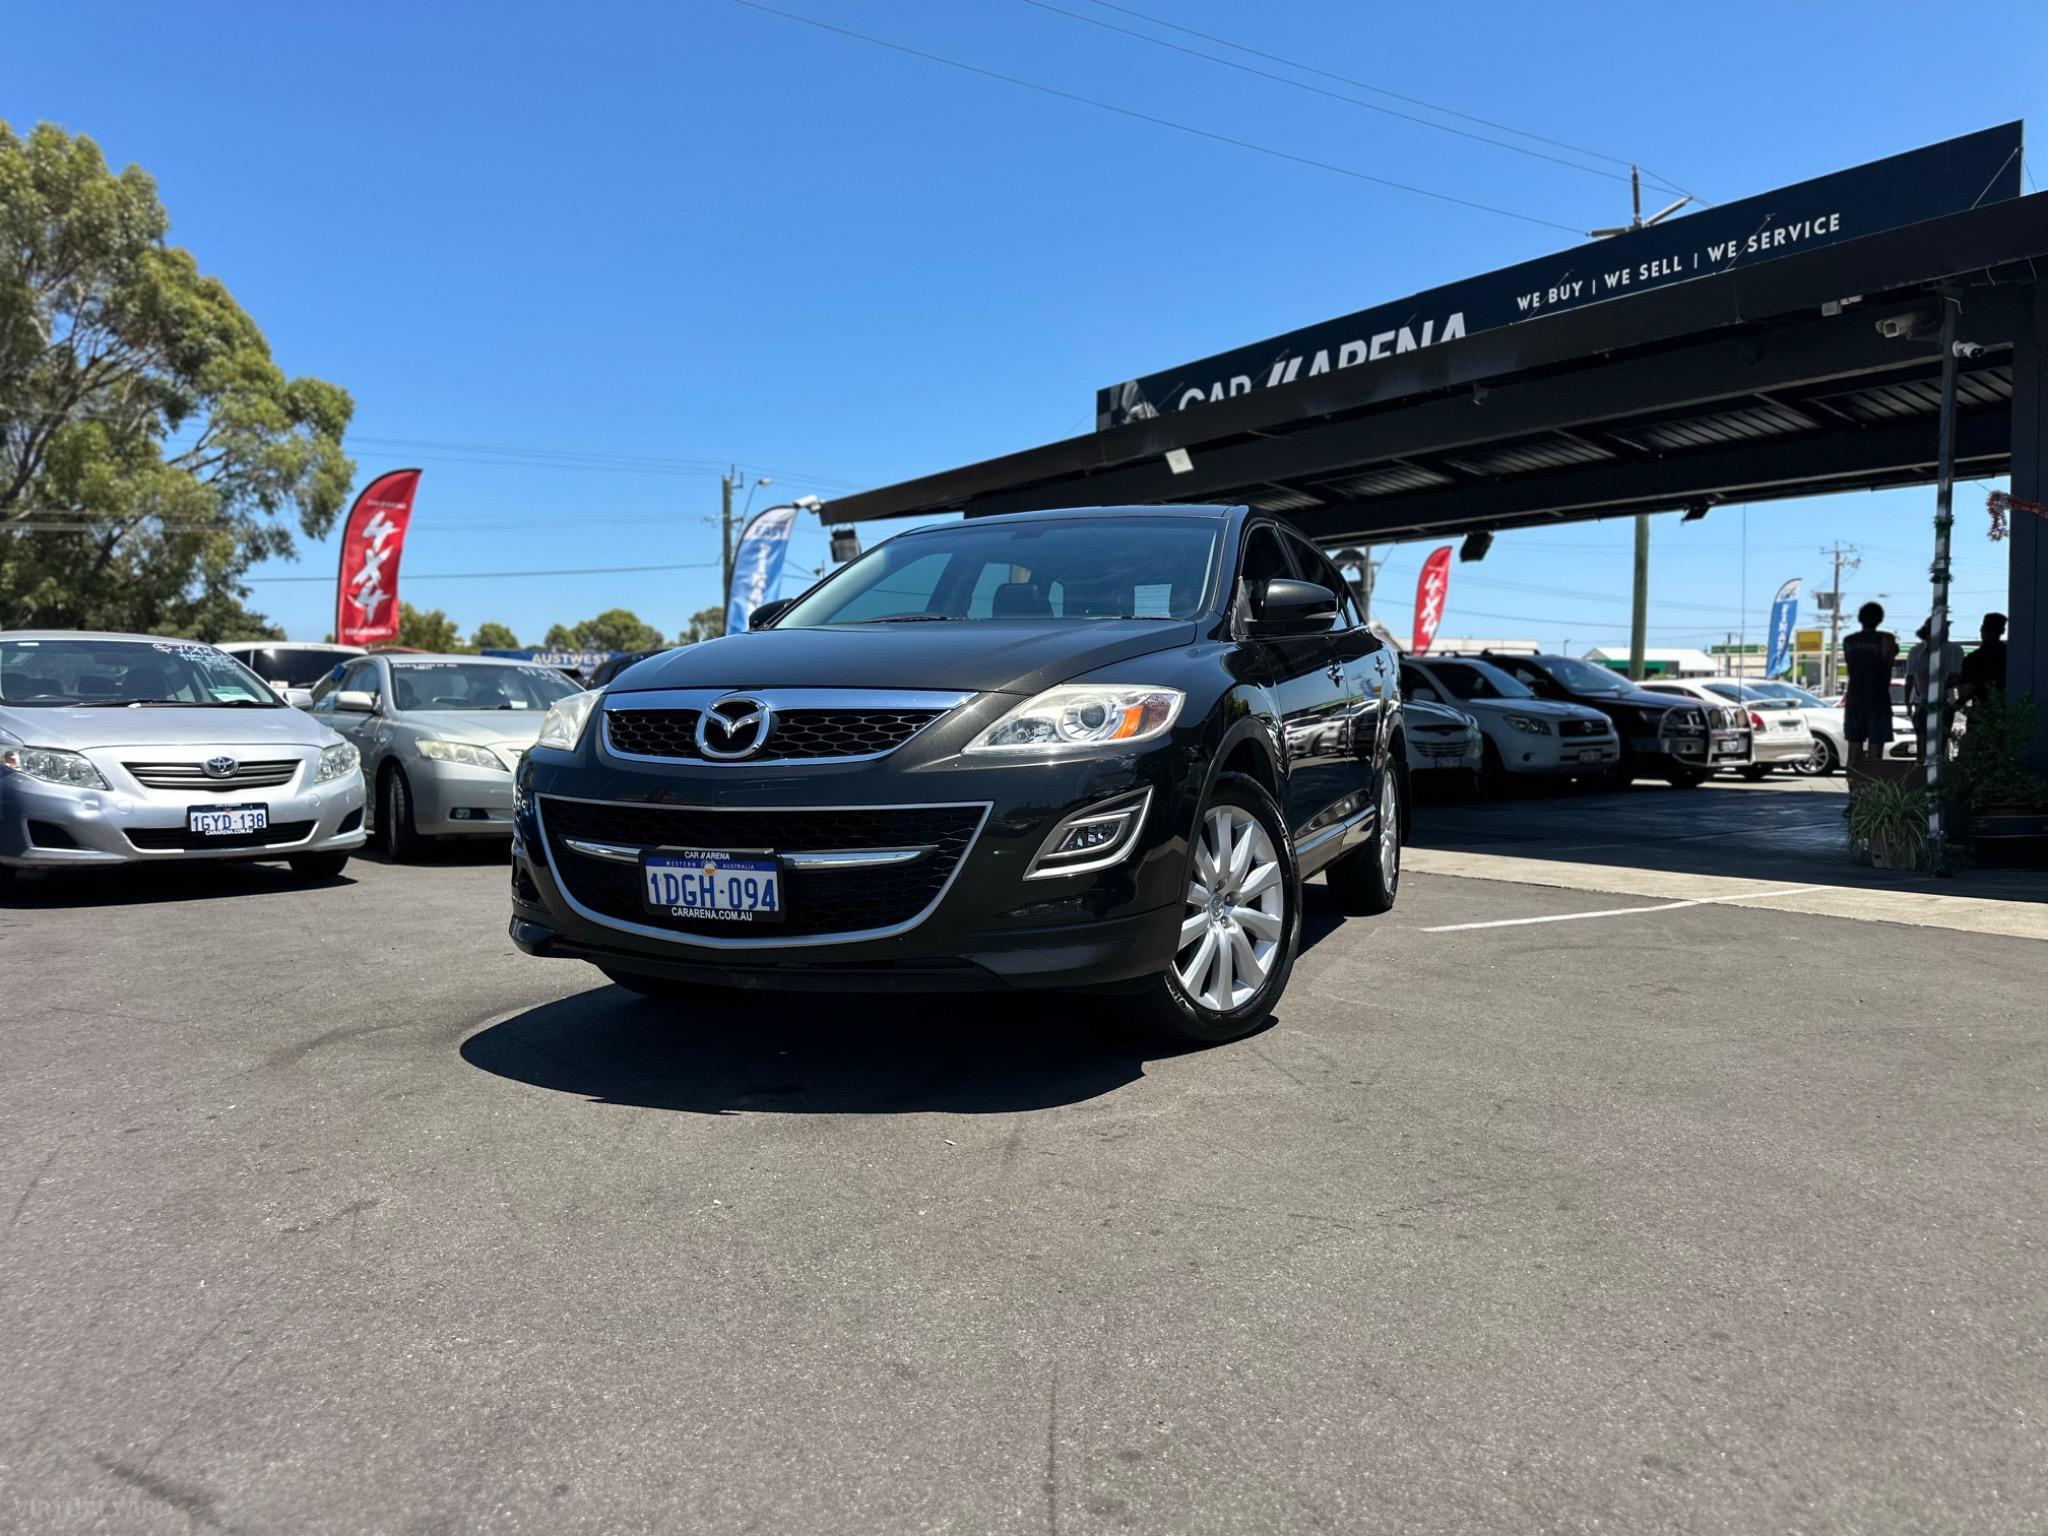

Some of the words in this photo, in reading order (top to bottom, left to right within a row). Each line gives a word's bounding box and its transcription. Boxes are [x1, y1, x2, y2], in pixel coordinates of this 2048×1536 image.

[1517, 291, 1540, 311] WE
[1548, 281, 1583, 303] BUY
[1604, 269, 1630, 289] WE
[1640, 255, 1682, 280] SELL
[1707, 241, 1737, 263] WE
[1747, 213, 1840, 253] SERVICE
[684, 851, 699, 860] CAR
[666, 860, 697, 868] WESTERN
[671, 906, 753, 922] CARARENA.COM.AU
